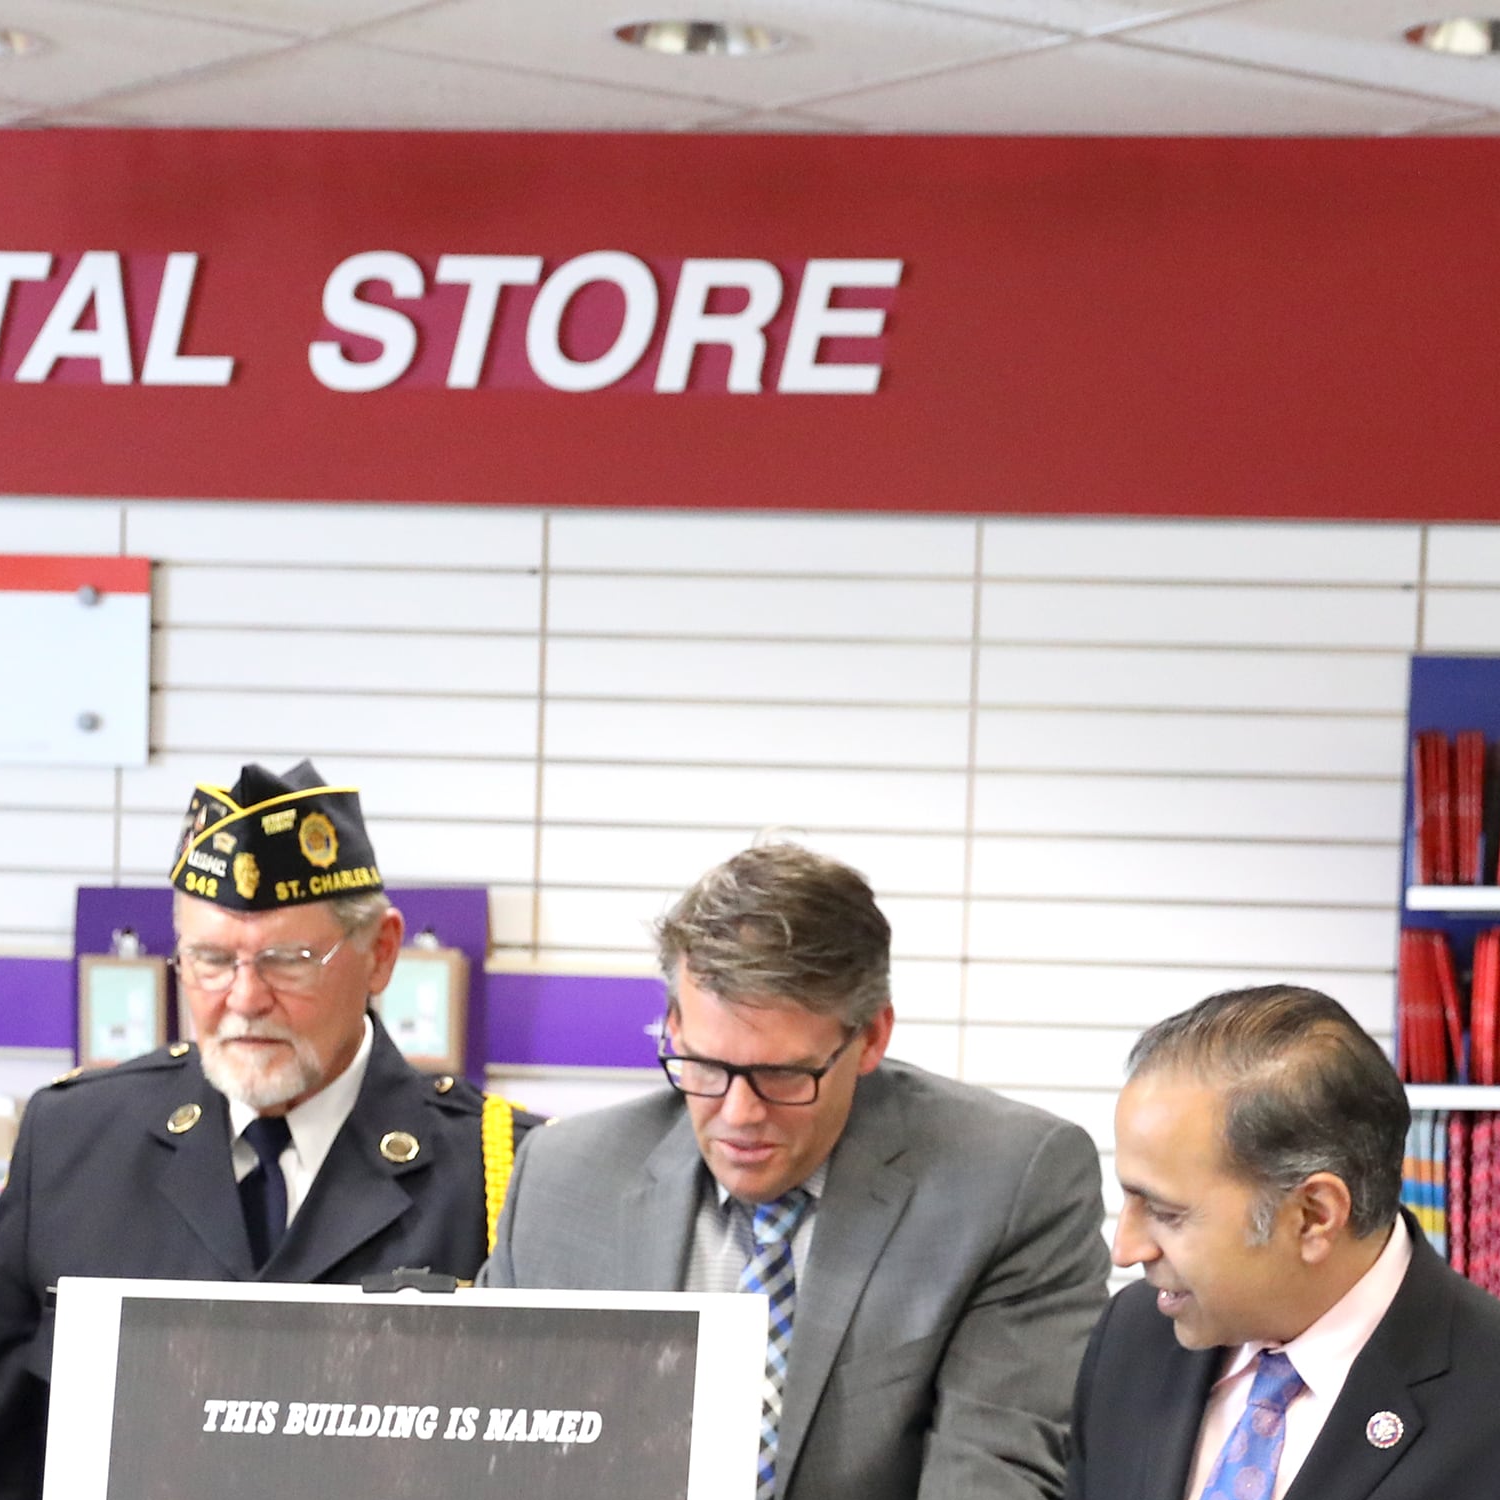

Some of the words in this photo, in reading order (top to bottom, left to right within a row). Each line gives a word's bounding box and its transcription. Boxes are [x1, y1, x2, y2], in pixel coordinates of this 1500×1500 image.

[309, 250, 904, 394] STORE
[275, 880, 306, 902] ST.
[203, 1400, 279, 1437] THIS
[283, 1402, 438, 1442] BUILDING
[444, 1406, 480, 1442] IS
[484, 1408, 602, 1445] NAMED
